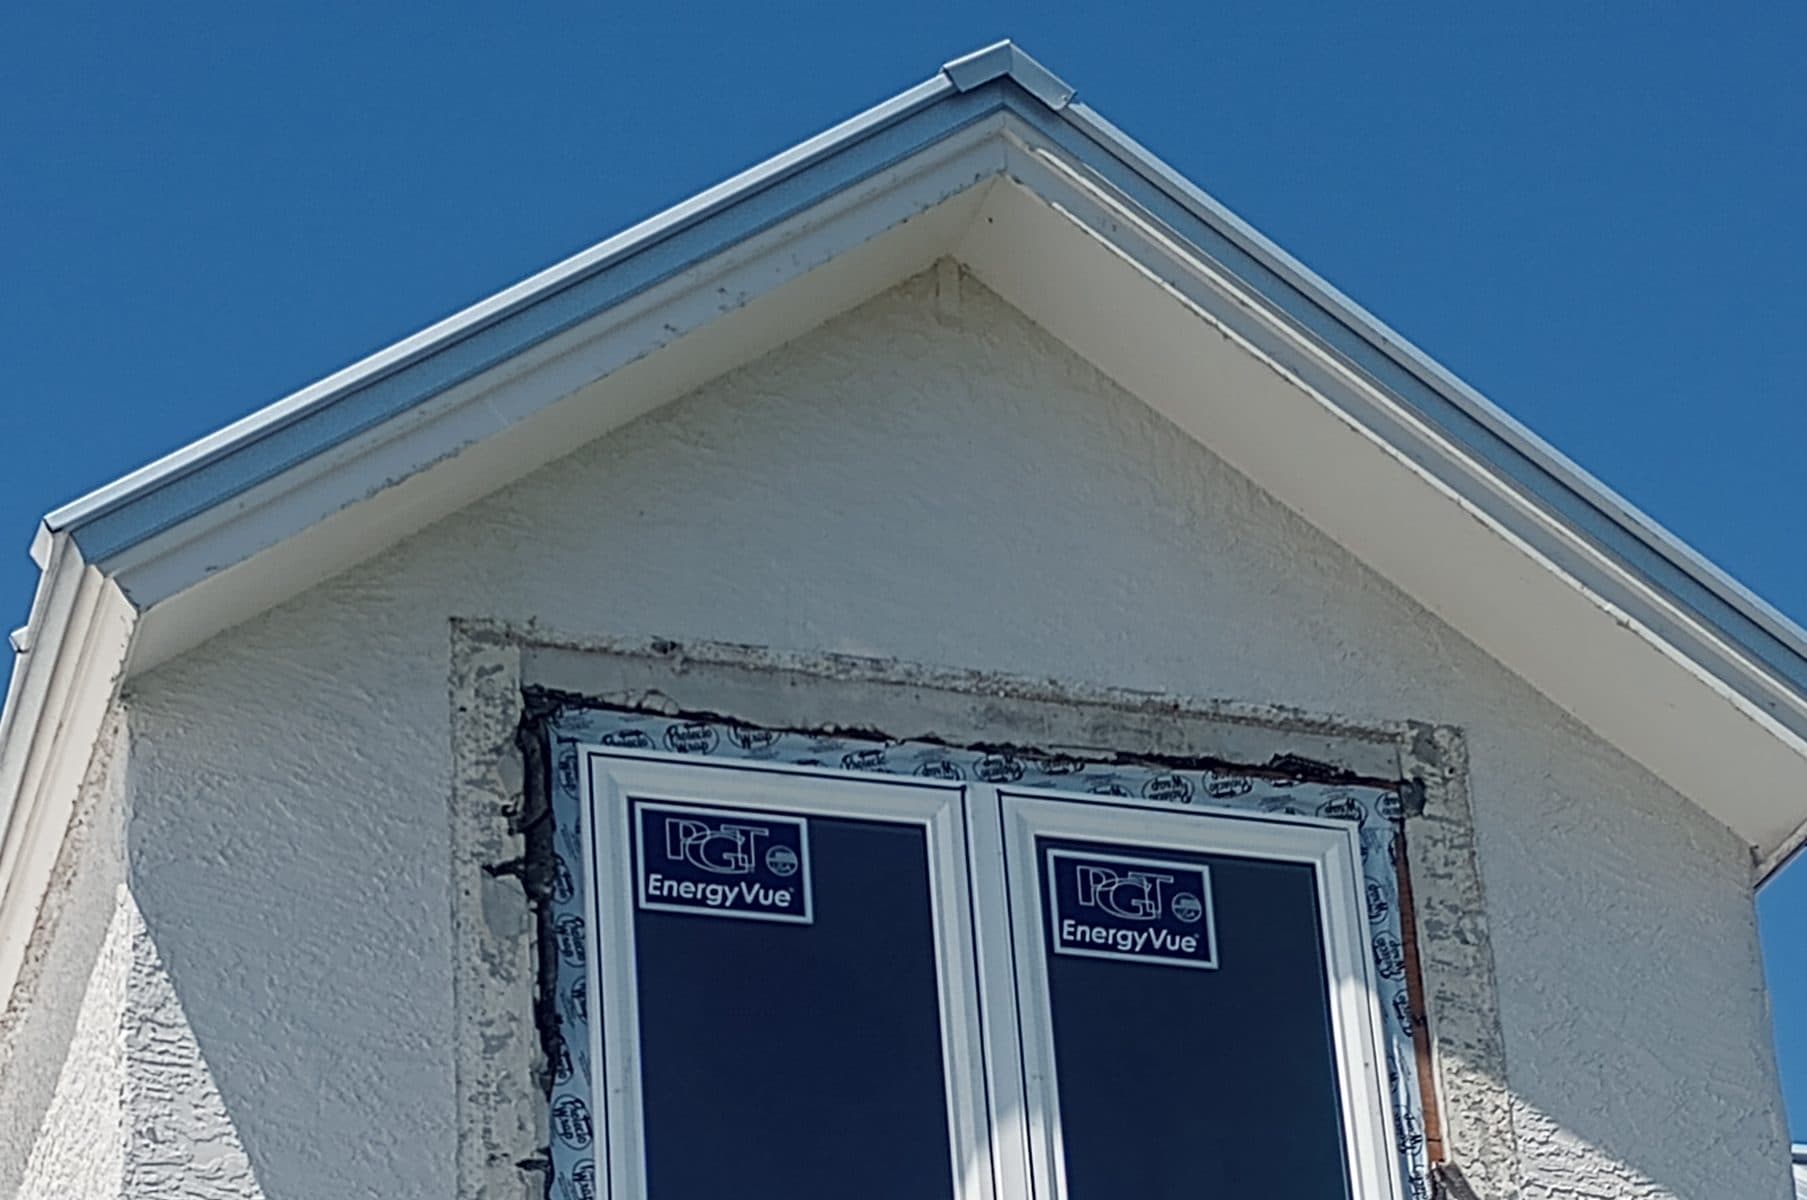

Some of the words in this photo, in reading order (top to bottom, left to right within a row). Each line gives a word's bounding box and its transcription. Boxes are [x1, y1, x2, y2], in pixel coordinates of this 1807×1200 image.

[665, 818, 769, 874] PGT
[648, 873, 792, 907] EnergyVue
[1076, 865, 1174, 920] PGT
[1062, 919, 1198, 953] EnergyVue
